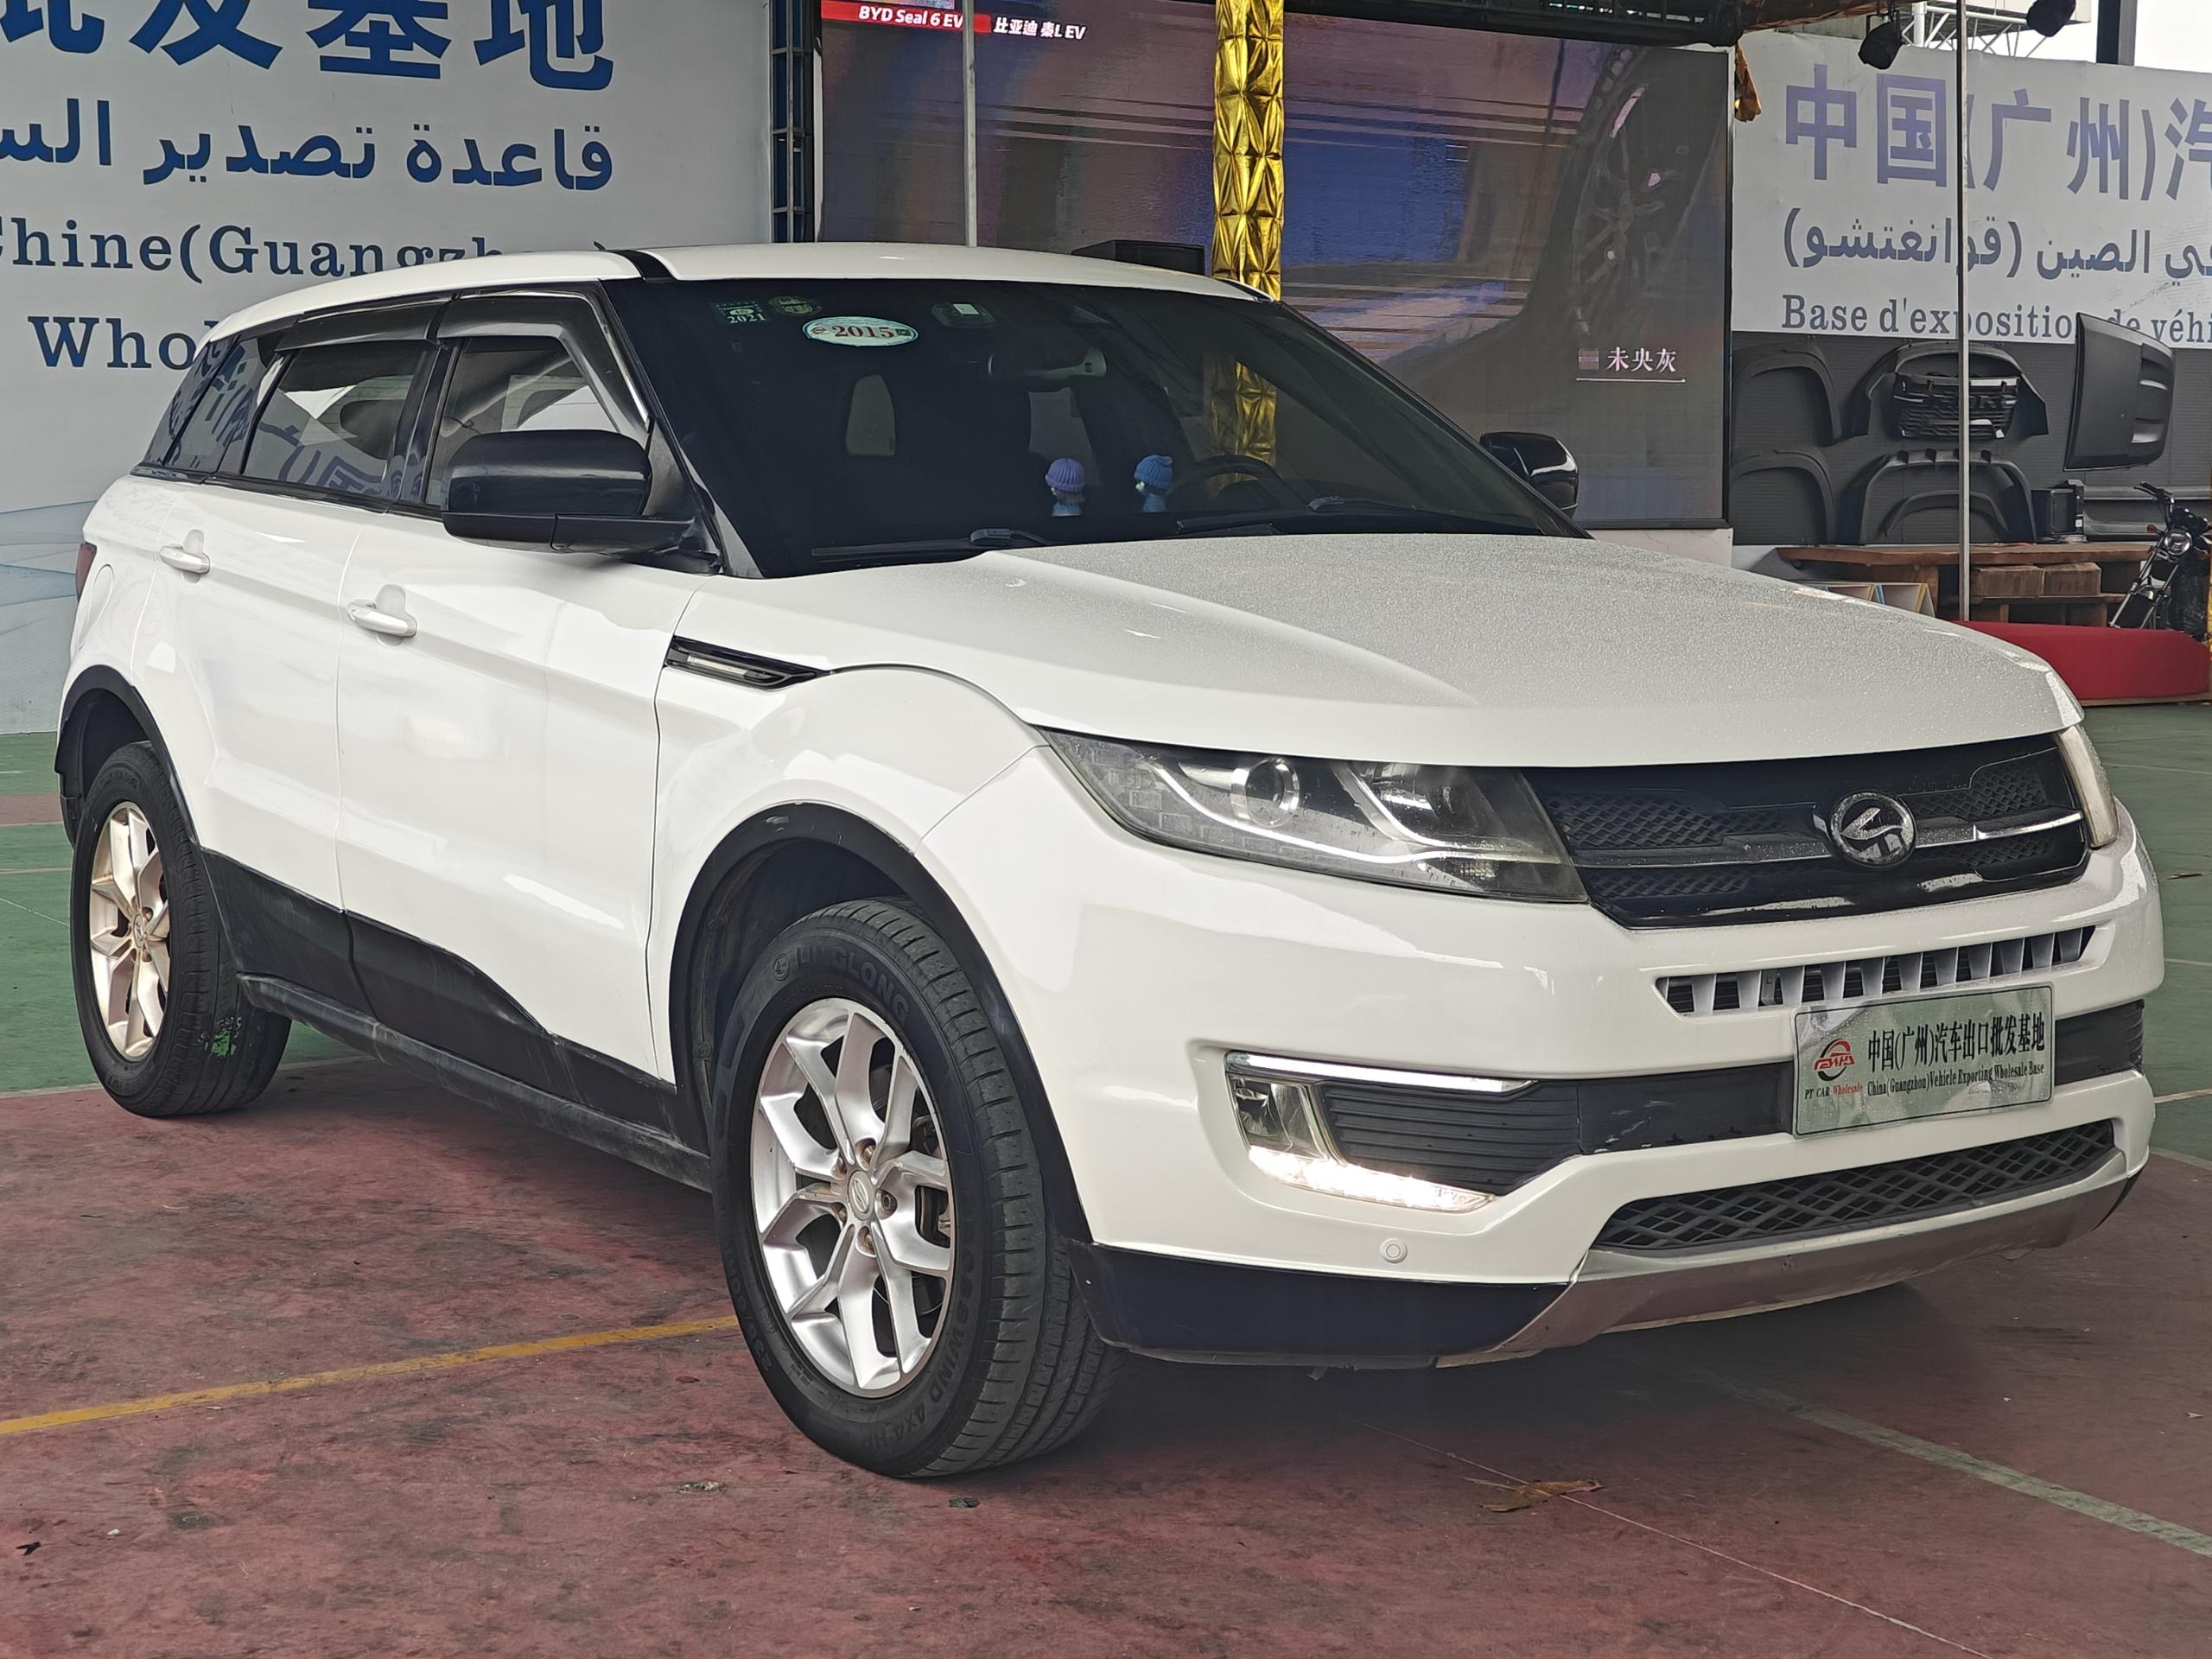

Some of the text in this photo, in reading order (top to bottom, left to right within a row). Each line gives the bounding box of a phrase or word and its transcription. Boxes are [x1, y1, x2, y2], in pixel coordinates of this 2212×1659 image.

[859, 5, 963, 28] BYD Seal 6 EV
[993, 16, 1038, 36] 比亚迪
[1065, 25, 1086, 40] EV
[143, 124, 375, 185] تصدير
[406, 124, 613, 191] قاعدة
[2037, 229, 2150, 280] الصين
[728, 313, 766, 324] 2021
[1782, 295, 1867, 332] Base
[2151, 308, 2212, 343] véh
[28, 315, 219, 370] Who
[834, 325, 896, 340] 2015
[1606, 346, 1676, 373] 未央灰
[1867, 1011, 2046, 1073] 中国(广州)汽车出口批发基地
[1957, 1065, 1993, 1086] Exporting
[1993, 1061, 2028, 1080] Wholesale
[2029, 1060, 2045, 1076] Base
[1804, 1088, 1814, 1099] PT
[1815, 1085, 1831, 1097] CAR
